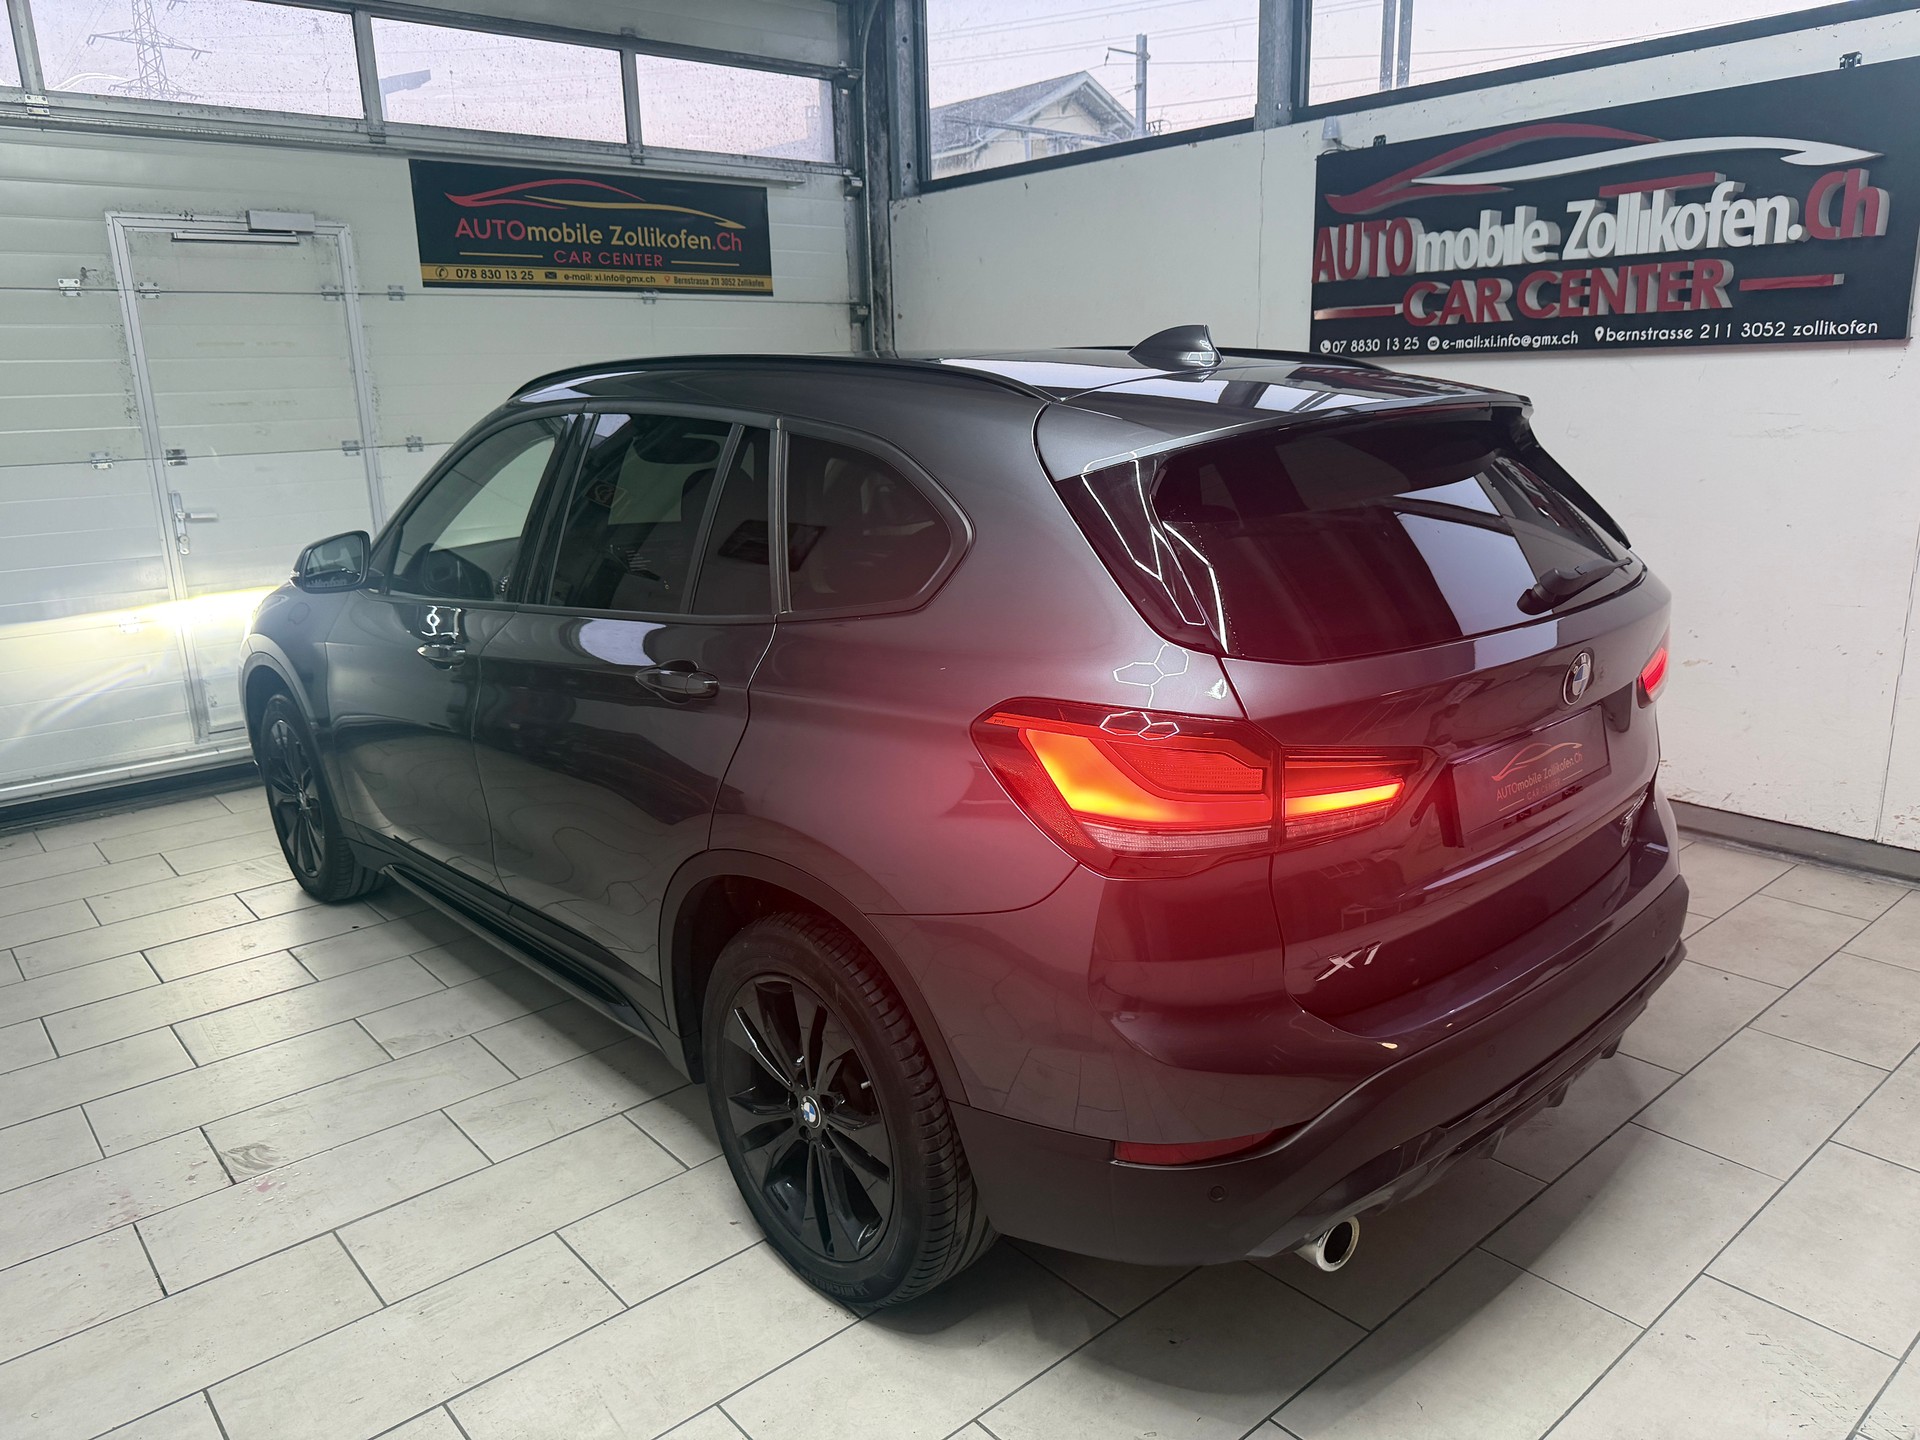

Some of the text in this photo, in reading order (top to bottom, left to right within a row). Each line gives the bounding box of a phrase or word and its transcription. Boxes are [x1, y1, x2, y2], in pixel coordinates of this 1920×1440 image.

[1562, 169, 1888, 261] Zollikofen.Ch
[455, 218, 743, 252] AUTOmobile Zollikofen.Ch
[553, 249, 663, 267] CAR CENTER
[456, 268, 477, 279] 078
[481, 269, 502, 280] 830
[505, 270, 518, 280] 13
[520, 270, 534, 281] 25
[564, 273, 593, 281] e-mail:
[674, 277, 709, 286] Bernstrasse
[711, 278, 720, 287] 211
[721, 279, 736, 287] 3052
[738, 279, 764, 287] Zollikofen
[1403, 259, 1734, 327] CAR CENTER
[1332, 340, 1348, 353] 07
[1351, 338, 1381, 352] 8830
[1387, 337, 1400, 351] 13
[1404, 336, 1421, 350] 25
[1606, 326, 1694, 342] bernstrasse
[1700, 324, 1733, 339] 211
[1741, 321, 1786, 337] 3052
[1793, 320, 1879, 336] zollikofen
[1314, 941, 1383, 982] X1
